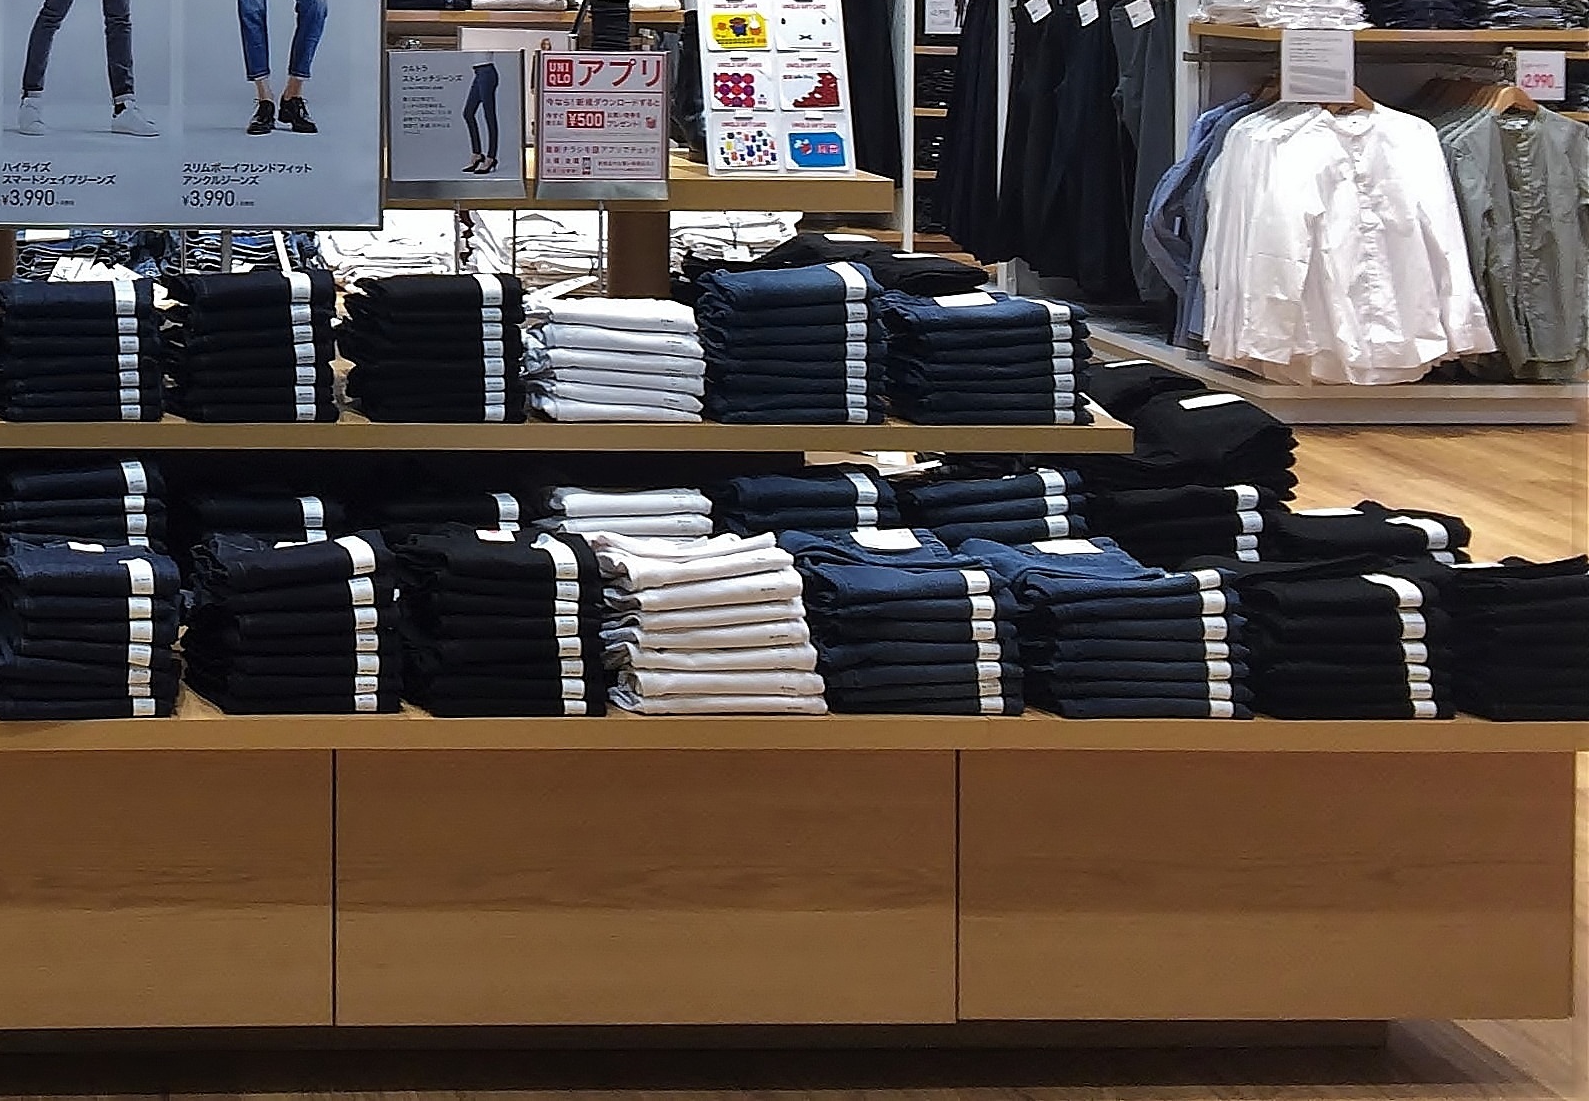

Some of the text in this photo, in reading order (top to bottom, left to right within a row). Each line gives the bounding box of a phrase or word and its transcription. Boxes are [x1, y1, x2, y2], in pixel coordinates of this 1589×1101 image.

[549, 62, 570, 73] UNI
[578, 58, 661, 88] アプリ
[549, 73, 571, 85] QLO
[568, 113, 603, 126] ¥500
[2, 162, 52, 173] ハイライズ
[182, 162, 313, 174] スリムボーイフレンドフィット
[1, 174, 117, 186] スマートシェイプジーンズ
[182, 175, 260, 186] アンクルジーンズ
[1, 189, 56, 207] ¥3,990
[182, 189, 235, 208] ¥3,990
